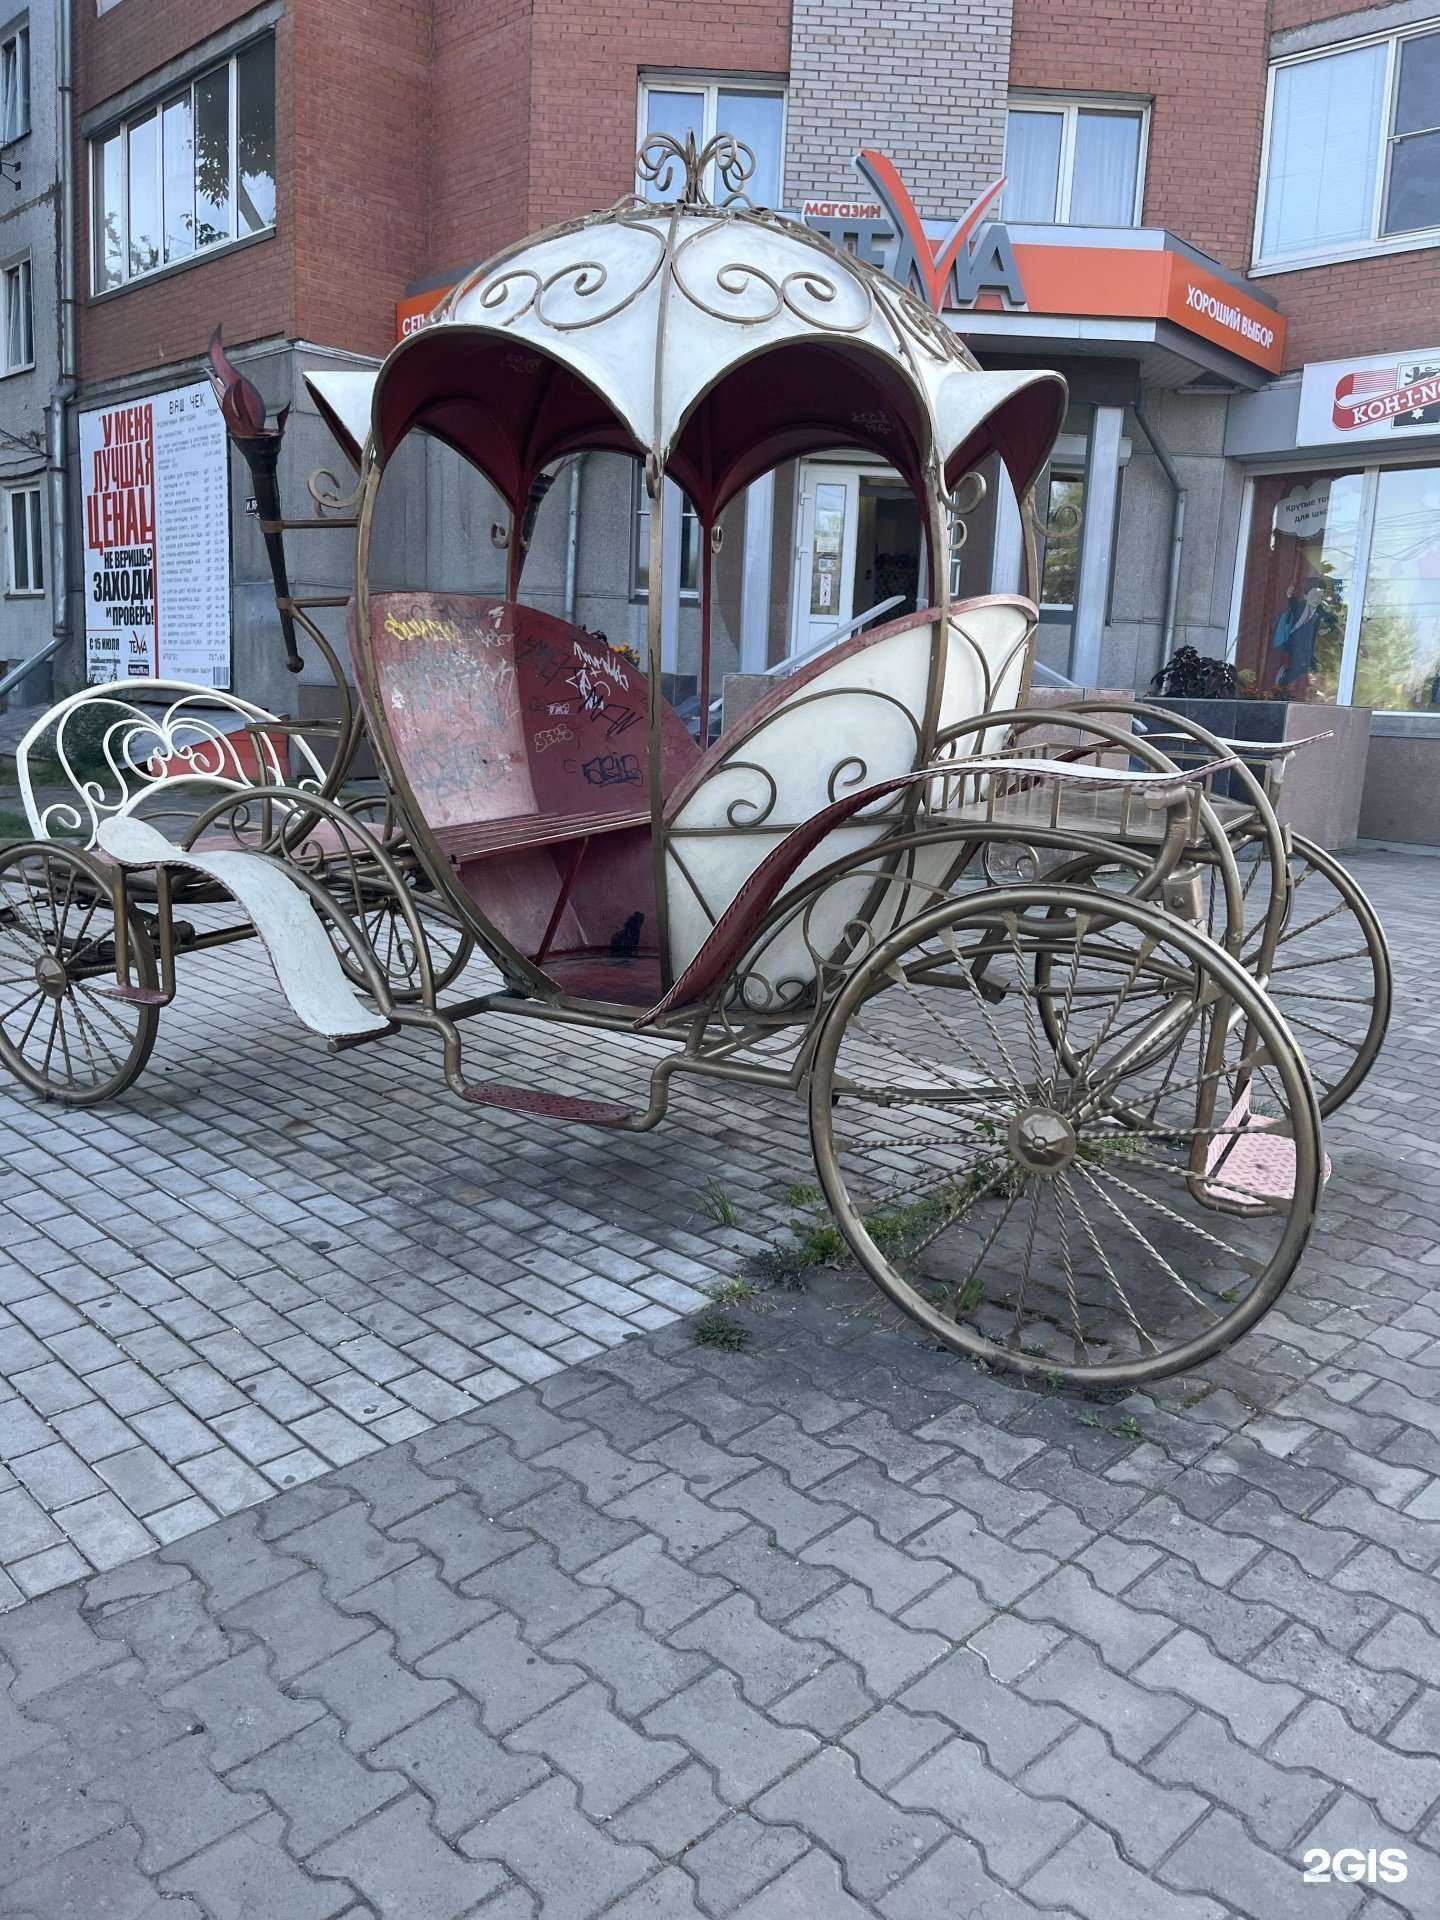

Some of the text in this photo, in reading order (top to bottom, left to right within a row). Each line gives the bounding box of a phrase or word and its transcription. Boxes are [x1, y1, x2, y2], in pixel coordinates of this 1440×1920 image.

[804, 202, 881, 219] магазин
[1186, 284, 1274, 349] ХОРОШИЙ ВЫБОР
[168, 393, 206, 415] ВАШ ЧЕК
[1352, 379, 1440, 425] KOH-I-N
[114, 403, 153, 446] МЕНЯ
[93, 441, 153, 494] ЛУЧШАЯ
[1285, 499, 1316, 513] Крутые
[1294, 513, 1310, 524] для
[104, 548, 153, 569] НЕ ВЕРИШЬ?
[93, 569, 153, 605] ЗАХОДИ
[112, 606, 154, 626] ПРОВЕРЬ!
[94, 638, 101, 651] 15
[102, 638, 120, 651] ИЮЛЯ
